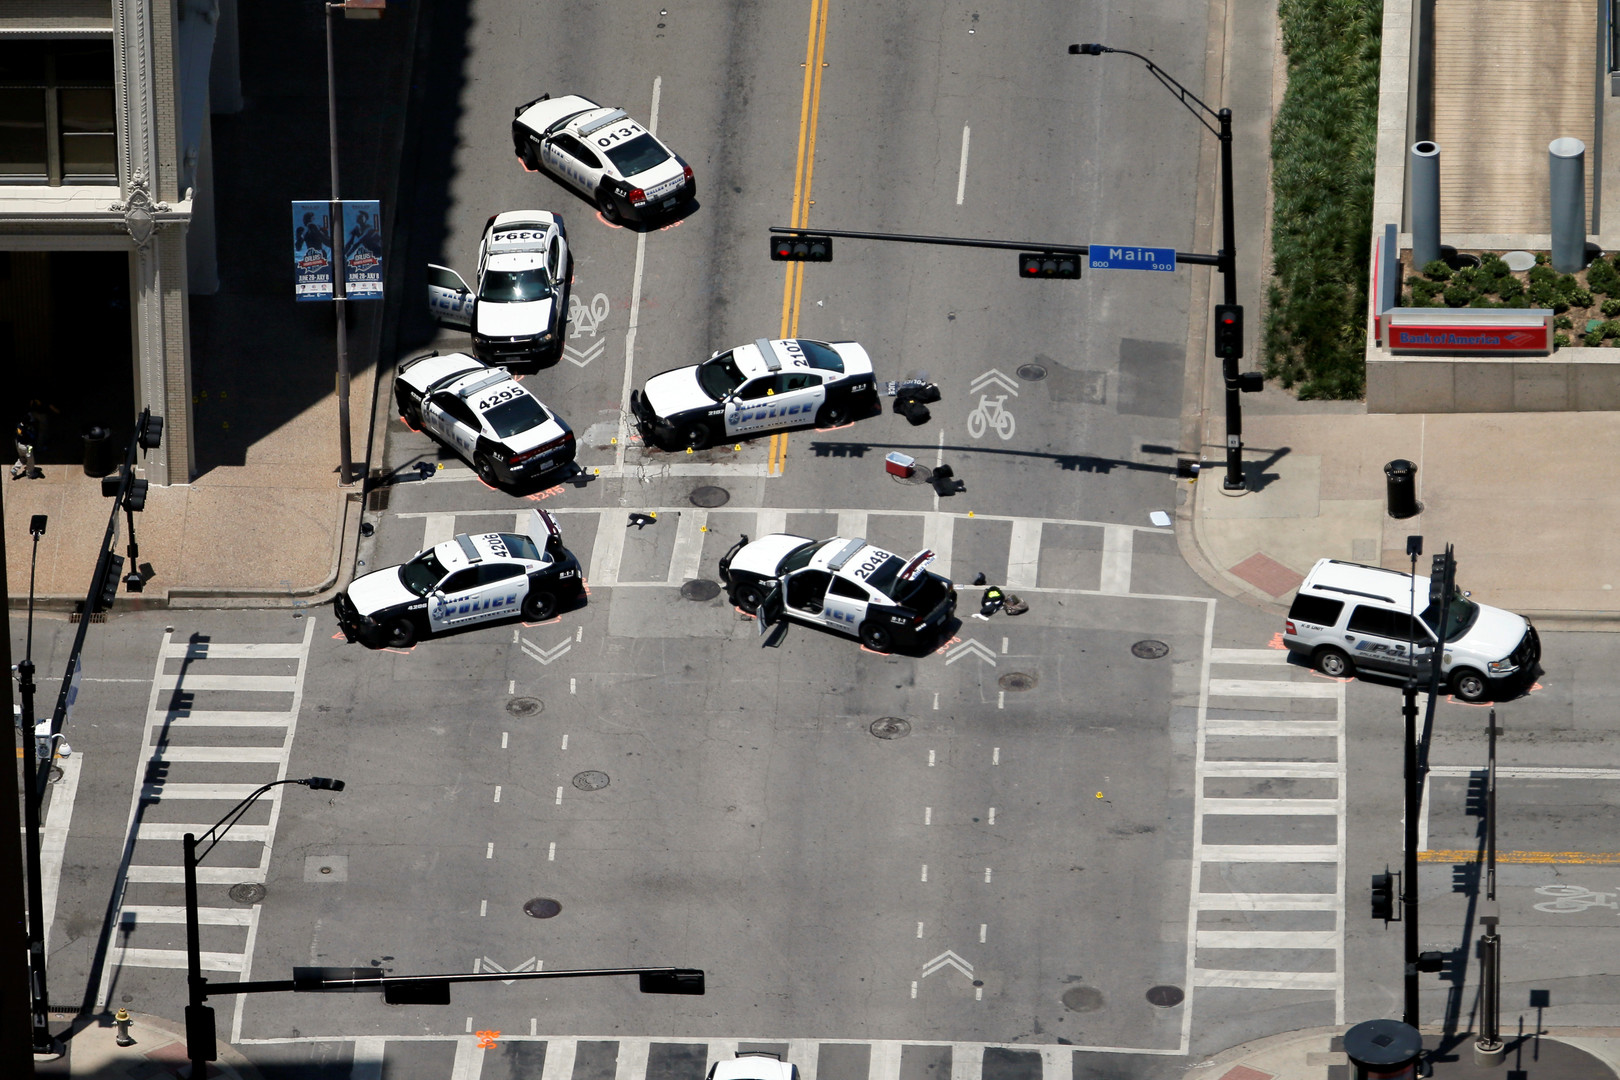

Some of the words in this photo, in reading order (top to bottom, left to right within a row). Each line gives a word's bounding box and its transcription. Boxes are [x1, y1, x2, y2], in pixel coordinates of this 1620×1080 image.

[597, 125, 641, 147] 0131
[494, 231, 545, 241] 0394
[1092, 260, 1109, 268] 800
[1109, 248, 1155, 262] Main
[1152, 263, 1172, 271] 900
[1400, 333, 1432, 344] Bank
[1433, 333, 1447, 344] of
[1448, 334, 1500, 345] America
[779, 340, 809, 368] 2107
[479, 386, 525, 410] 4295
[741, 401, 814, 422] POLICE
[483, 533, 508, 558] 4206
[854, 550, 890, 580] 2048
[444, 593, 517, 617] POLICE
